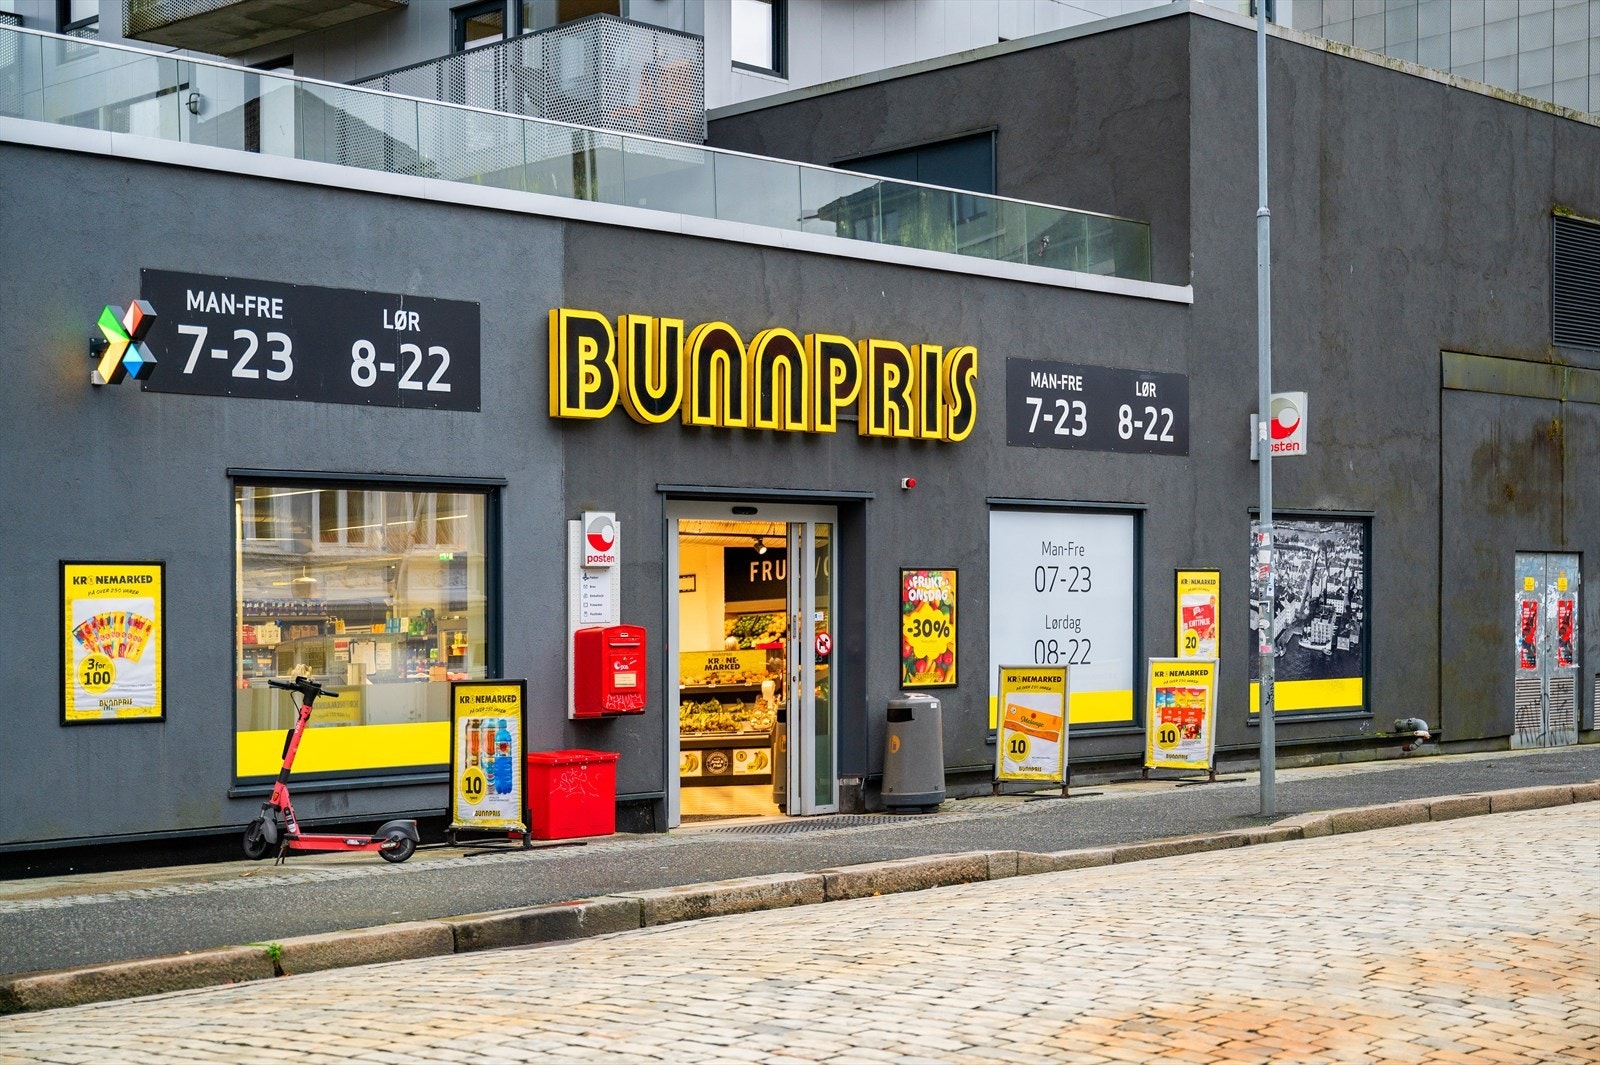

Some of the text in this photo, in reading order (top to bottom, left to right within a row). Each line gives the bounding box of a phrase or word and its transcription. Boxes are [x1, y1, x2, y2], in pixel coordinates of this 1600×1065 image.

[186, 289, 283, 320] MAN-FRE
[383, 308, 421, 333] LØR
[177, 324, 294, 382] 7-23
[350, 339, 452, 392] 8-22
[549, 308, 978, 443] BUNNPRIS
[1030, 371, 1083, 392] MAN-FRE
[1135, 381, 1157, 398] LØR
[1026, 396, 1088, 437] 7-23
[1118, 403, 1174, 442] 8-22
[1270, 442, 1300, 452] sten
[1041, 541, 1085, 556] Man-Fre
[587, 554, 615, 564] posten
[911, 575, 943, 589] FRUKT
[1034, 565, 1092, 593] 07-23
[908, 588, 948, 602] ONSDAG
[907, 618, 950, 638] -30%
[1045, 615, 1082, 633] Lørdag
[1034, 638, 1092, 665] 08-22
[1185, 636, 1197, 649] 20
[87, 658, 106, 671] 3 for
[84, 671, 111, 685] 100
[1160, 730, 1176, 743] 10
[1010, 739, 1026, 754] 10
[465, 776, 482, 795] 10
